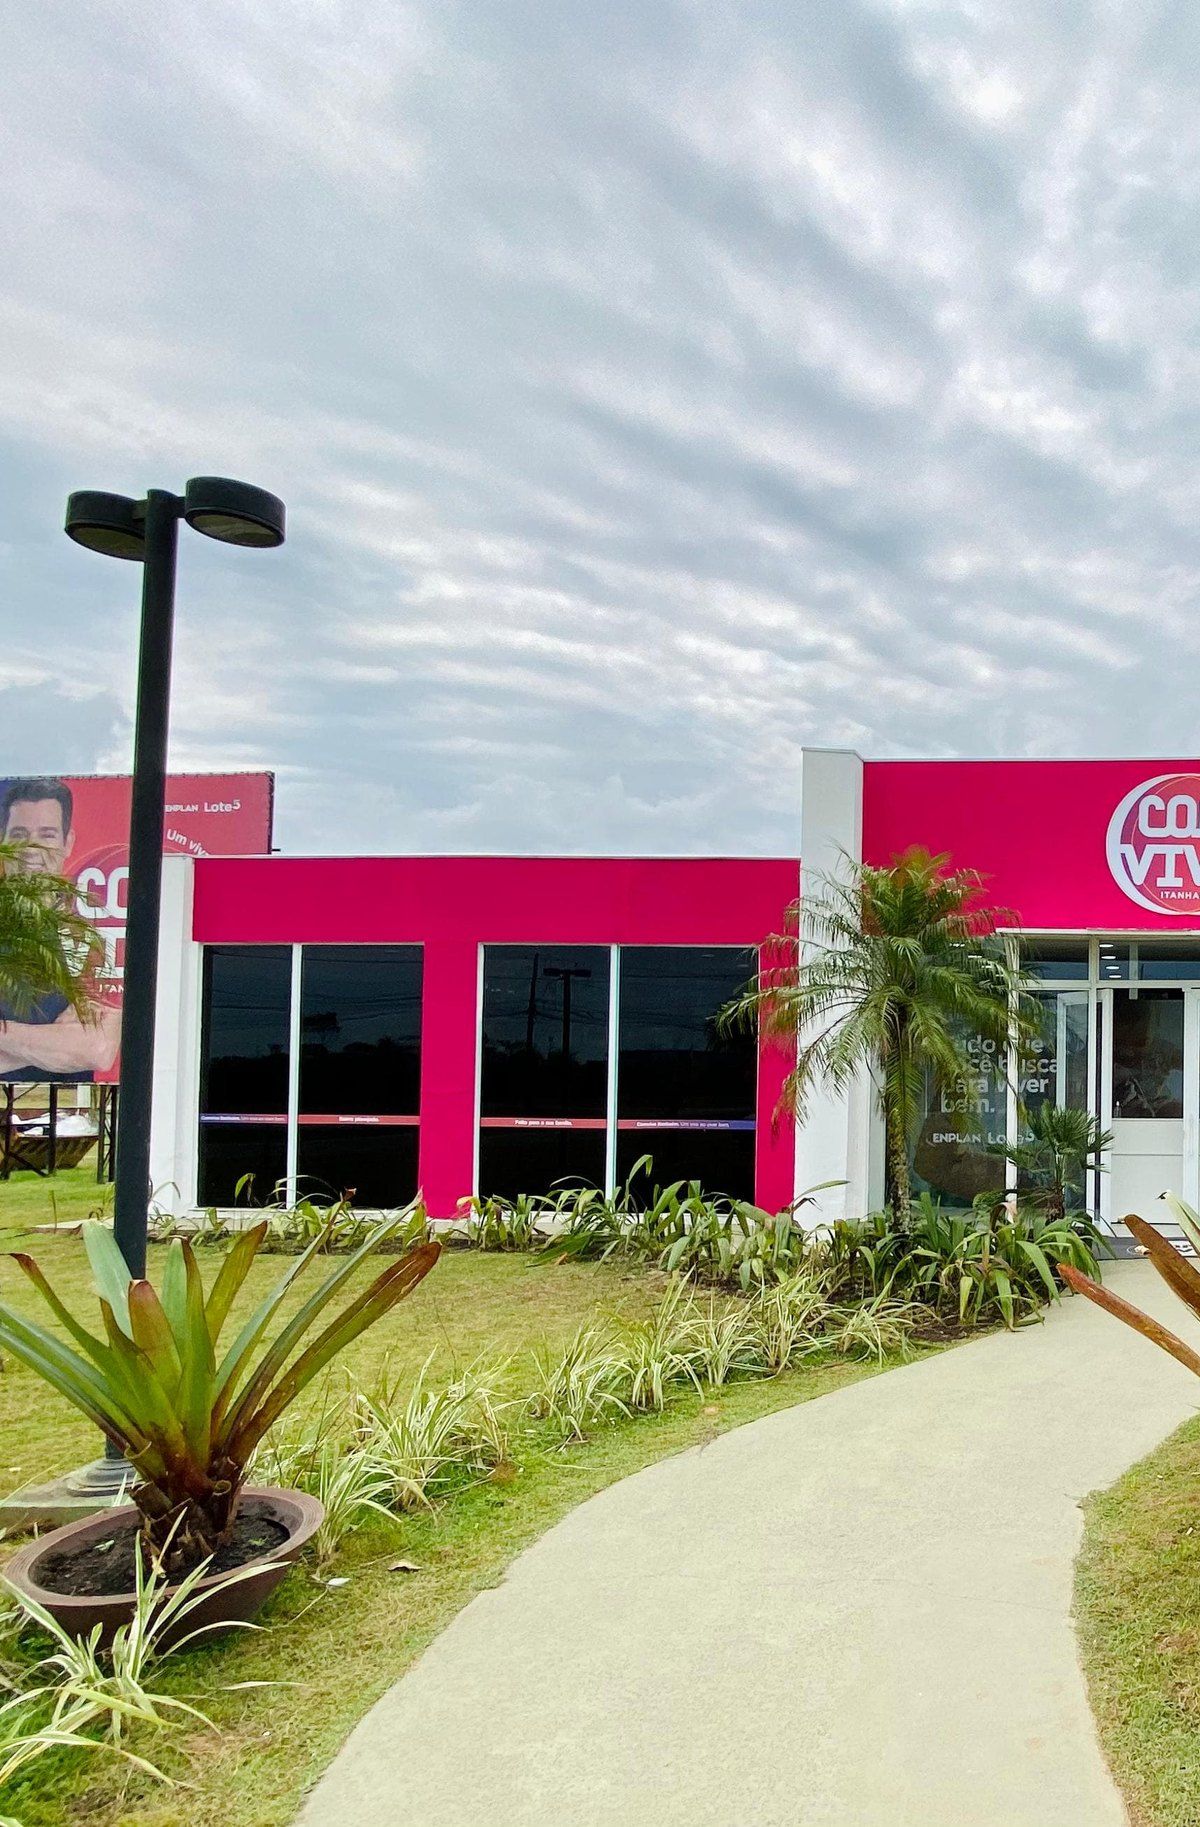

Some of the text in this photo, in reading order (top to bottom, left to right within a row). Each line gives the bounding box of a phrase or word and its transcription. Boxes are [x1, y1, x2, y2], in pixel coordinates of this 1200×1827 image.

[166, 828, 210, 856] Um viv
[76, 867, 130, 919] CO
[932, 1132, 981, 1143] ENPLAN
